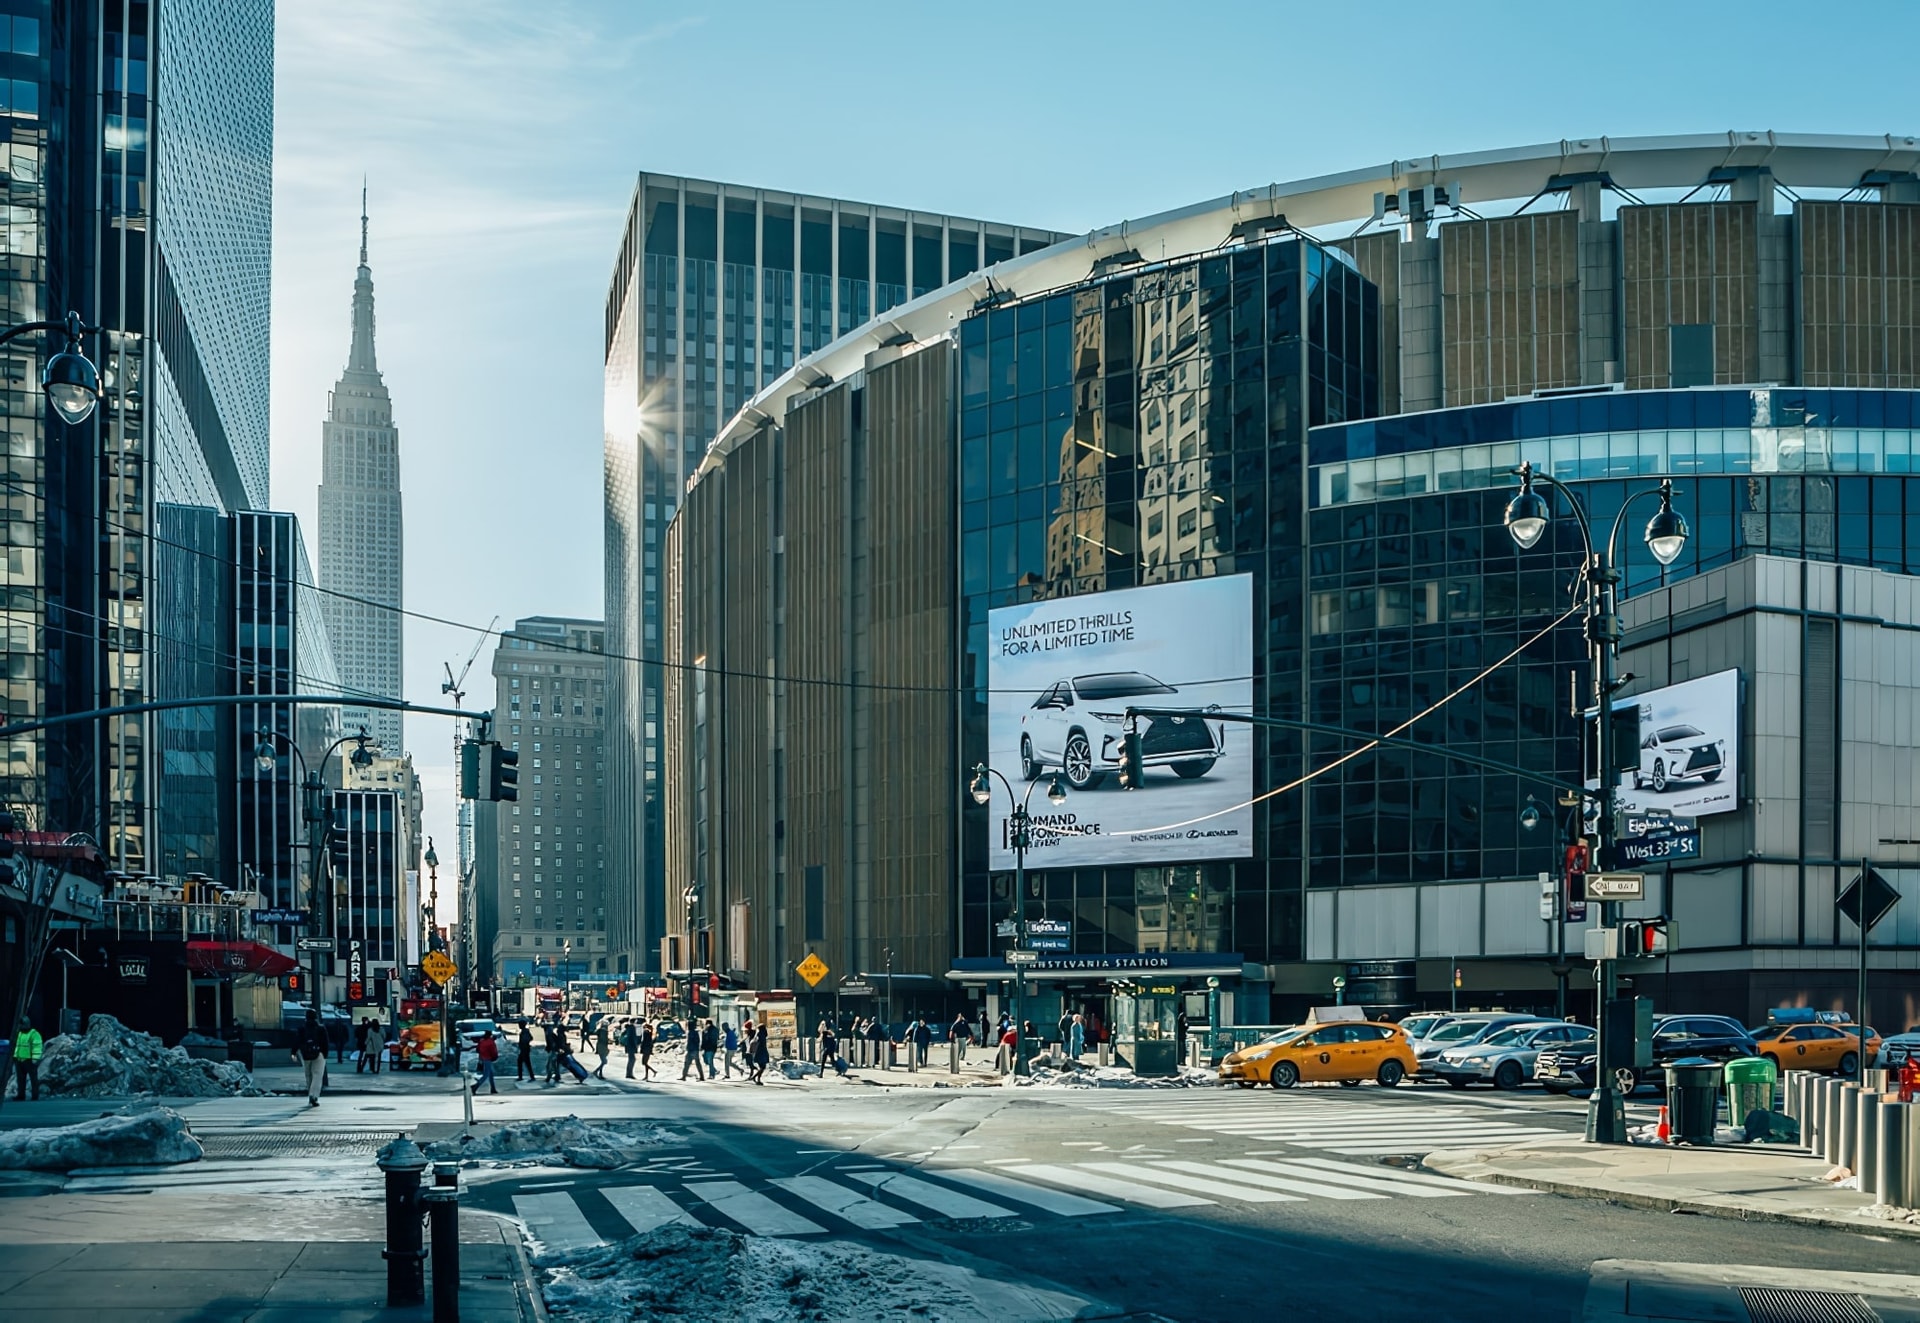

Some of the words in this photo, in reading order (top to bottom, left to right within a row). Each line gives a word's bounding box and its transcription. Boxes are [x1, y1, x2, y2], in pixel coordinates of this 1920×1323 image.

[1002, 619, 1077, 641] UNLIMITED
[1079, 610, 1133, 630] THRILLS
[1002, 641, 1029, 656] FOR
[1031, 639, 1041, 653] A
[1044, 632, 1098, 651] LIMITED
[1101, 626, 1135, 643] TIME
[1027, 813, 1077, 827] MMAND
[1030, 823, 1101, 841] FORMANCE
[1624, 844, 1655, 860] West
[1655, 840, 1678, 856] 33rd
[1680, 837, 1693, 853] St
[350, 940, 361, 983] PARK
[1029, 959, 1109, 969] NNSYLVANIA
[1115, 958, 1168, 968] STATION
